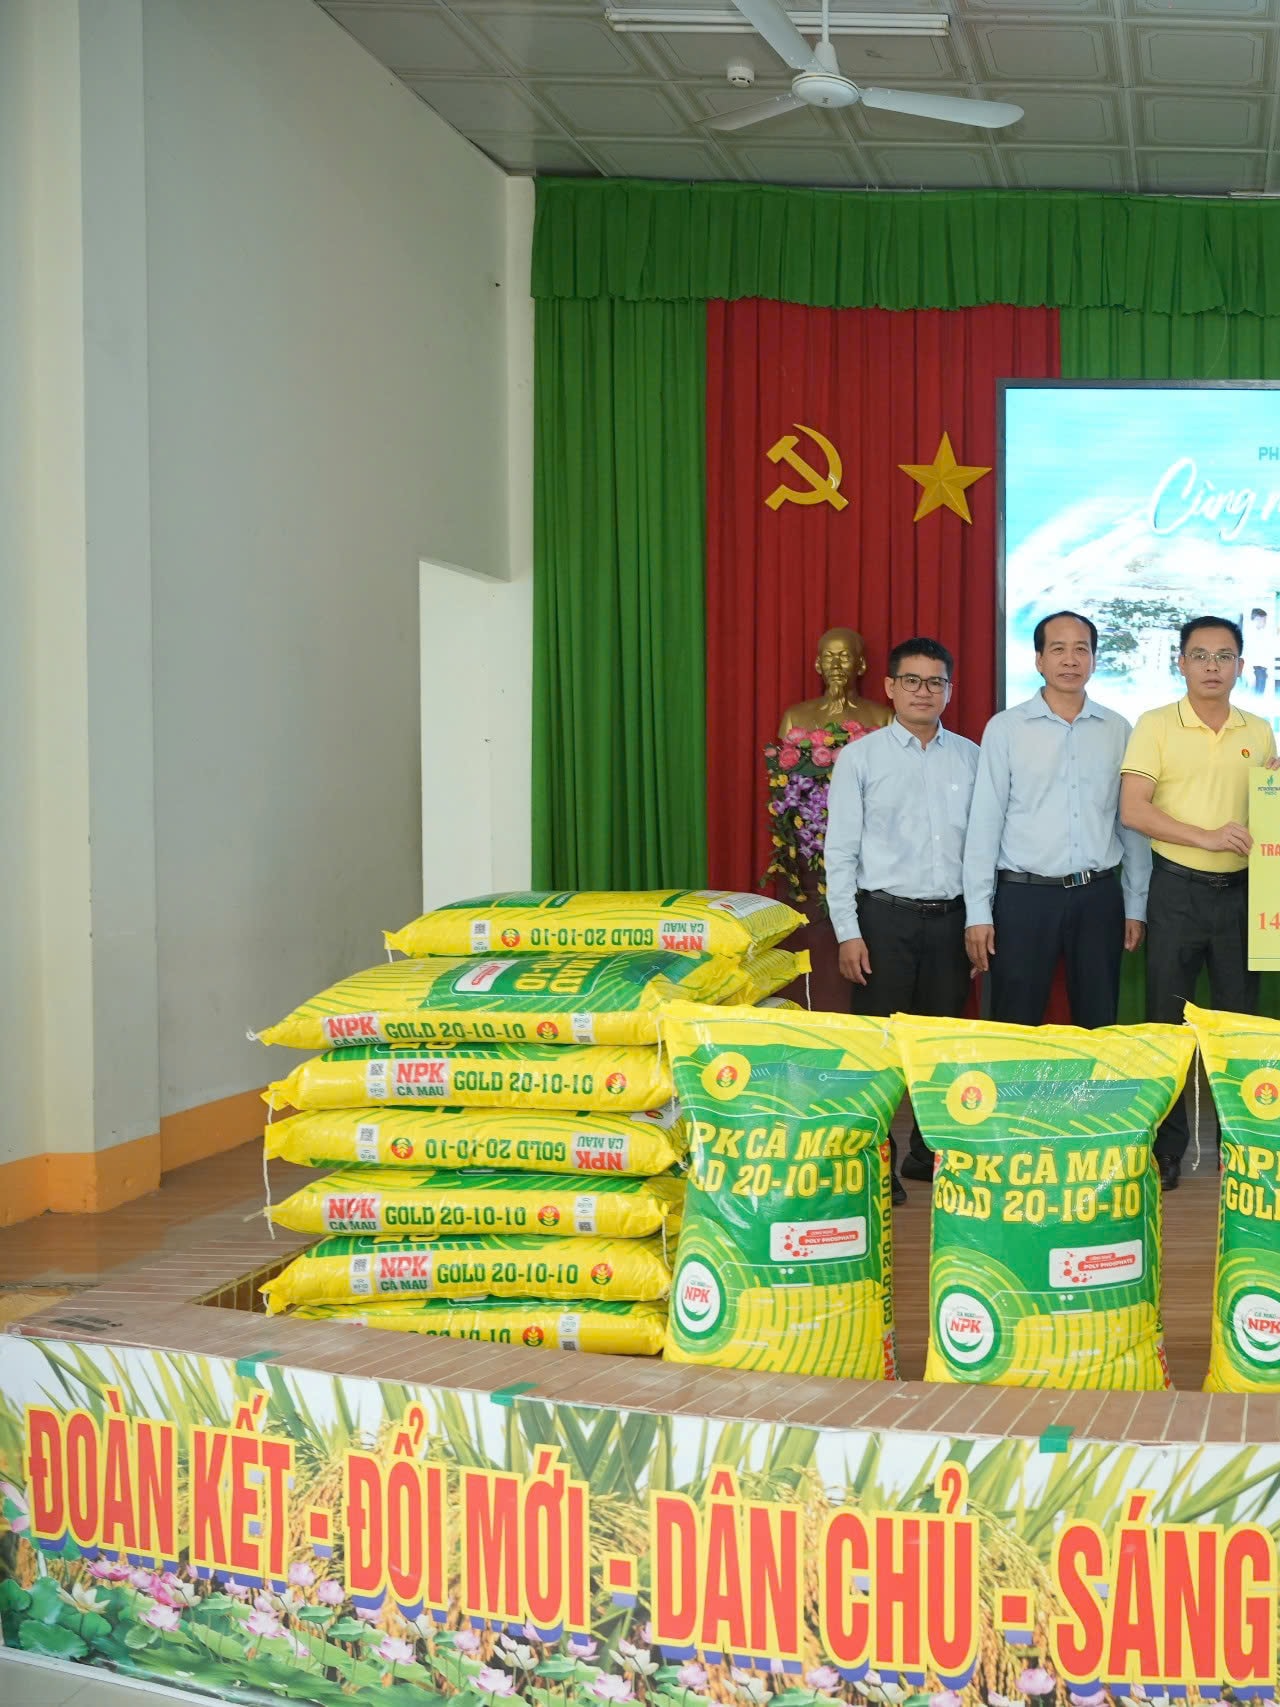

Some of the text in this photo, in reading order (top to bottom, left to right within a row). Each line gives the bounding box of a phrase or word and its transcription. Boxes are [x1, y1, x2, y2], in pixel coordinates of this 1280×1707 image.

[1150, 456, 1257, 543] Cùng
[530, 928, 654, 946] GOLD 20-10-10
[327, 1015, 378, 1039] NPK
[385, 1021, 526, 1040] GOLD 20-10-10
[396, 1062, 446, 1084] NPK
[454, 1070, 594, 1094] GOLD 20-10-10
[416, 1086, 444, 1096] MAU
[518, 1139, 567, 1162] GOLD
[745, 1121, 789, 1160] CÀ
[793, 1125, 873, 1161] MAU
[575, 1151, 624, 1170] NPK
[934, 1146, 1149, 1186] PK CÀ MAU
[731, 1158, 864, 1198] 20-10-10
[934, 1175, 1141, 1224] GOLD 20-10-10
[385, 1206, 527, 1226] GOLD 20-10-10
[380, 1255, 429, 1279] NPK
[436, 1262, 579, 1285] GOLD 20-10-10
[399, 1279, 428, 1290] MAU
[684, 1285, 710, 1304] NPK
[950, 1317, 982, 1334] NPK
[26, 1388, 177, 1557] ĐOÀN
[191, 1392, 293, 1577] KẾT
[345, 1405, 445, 1604] ĐỔI
[463, 1448, 590, 1627] MỚI
[654, 1470, 800, 1654] DÂN
[825, 1467, 975, 1670] CHỦ
[1055, 1494, 1273, 1679] SÁNG
